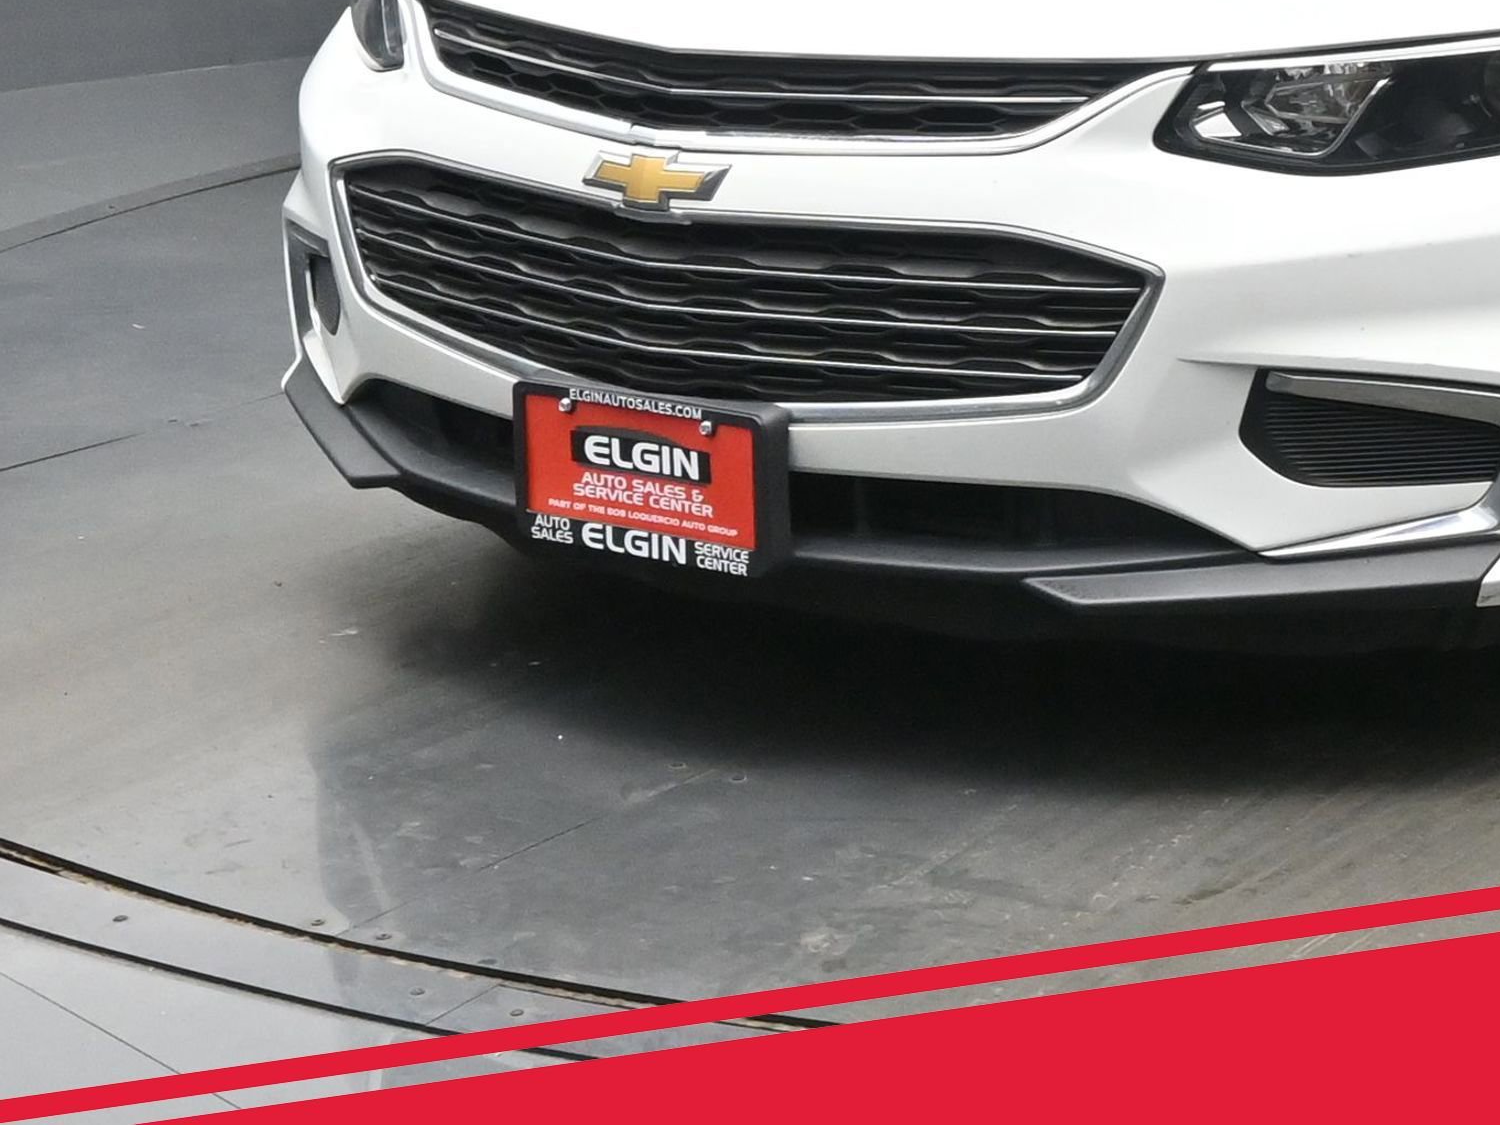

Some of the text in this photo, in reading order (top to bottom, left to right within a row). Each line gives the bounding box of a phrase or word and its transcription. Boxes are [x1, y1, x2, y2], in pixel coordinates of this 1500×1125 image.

[569, 388, 702, 420] ELGINAUTOSALES.COM
[584, 435, 700, 480] ELGIN
[573, 483, 713, 518] SERVICE CENTER
[581, 472, 704, 502] AUTO SALES &
[534, 514, 570, 531] AUTO
[548, 499, 571, 509] PART
[573, 502, 586, 510] OF
[588, 504, 605, 514] THE
[682, 520, 705, 531] AUTO
[707, 524, 738, 536] GROUP
[531, 526, 573, 544] SALES
[581, 523, 686, 565] ELGIN
[694, 542, 749, 563] SERVICE
[696, 555, 747, 576] CENTER
